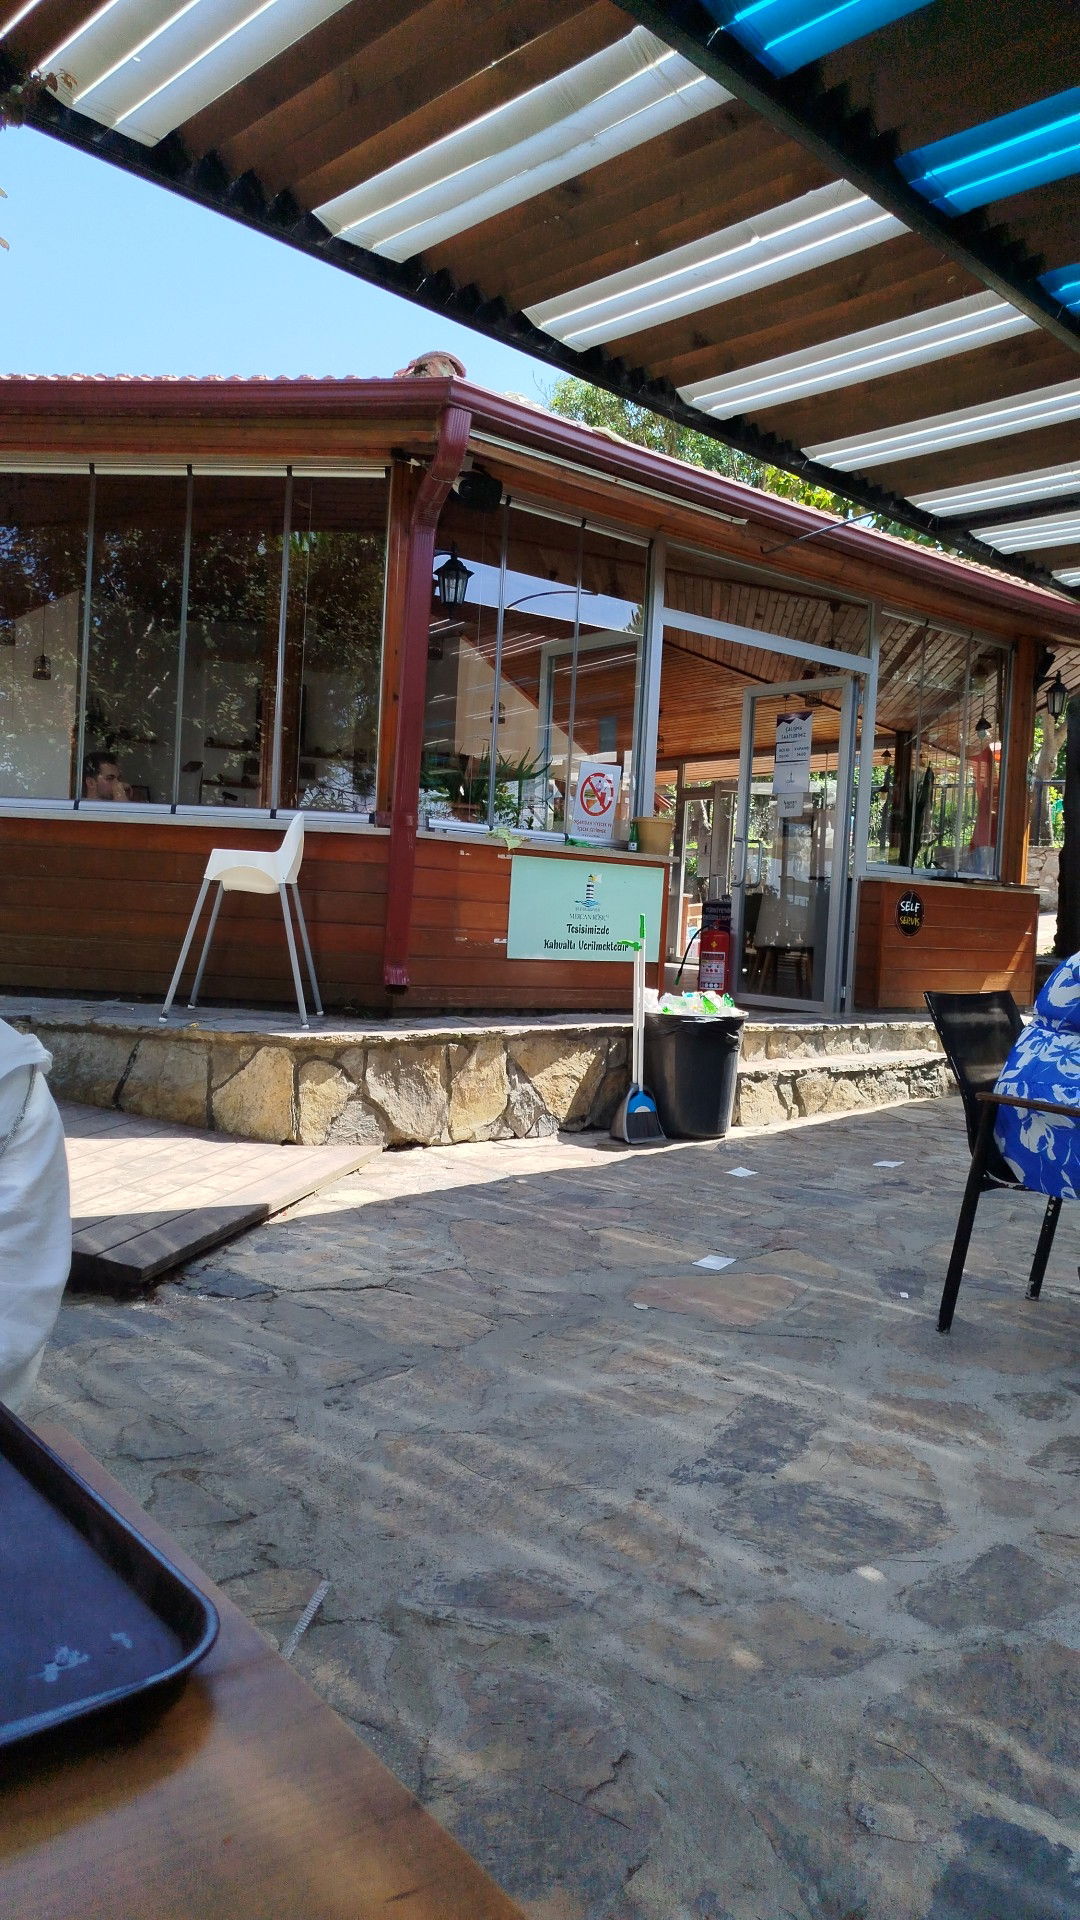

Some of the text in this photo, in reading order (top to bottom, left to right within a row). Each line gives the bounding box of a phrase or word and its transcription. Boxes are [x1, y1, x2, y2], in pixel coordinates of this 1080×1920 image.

[900, 901, 920, 912] SELF
[566, 924, 610, 935] Tesisimizde
[543, 939, 576, 950] Kahvaltı
